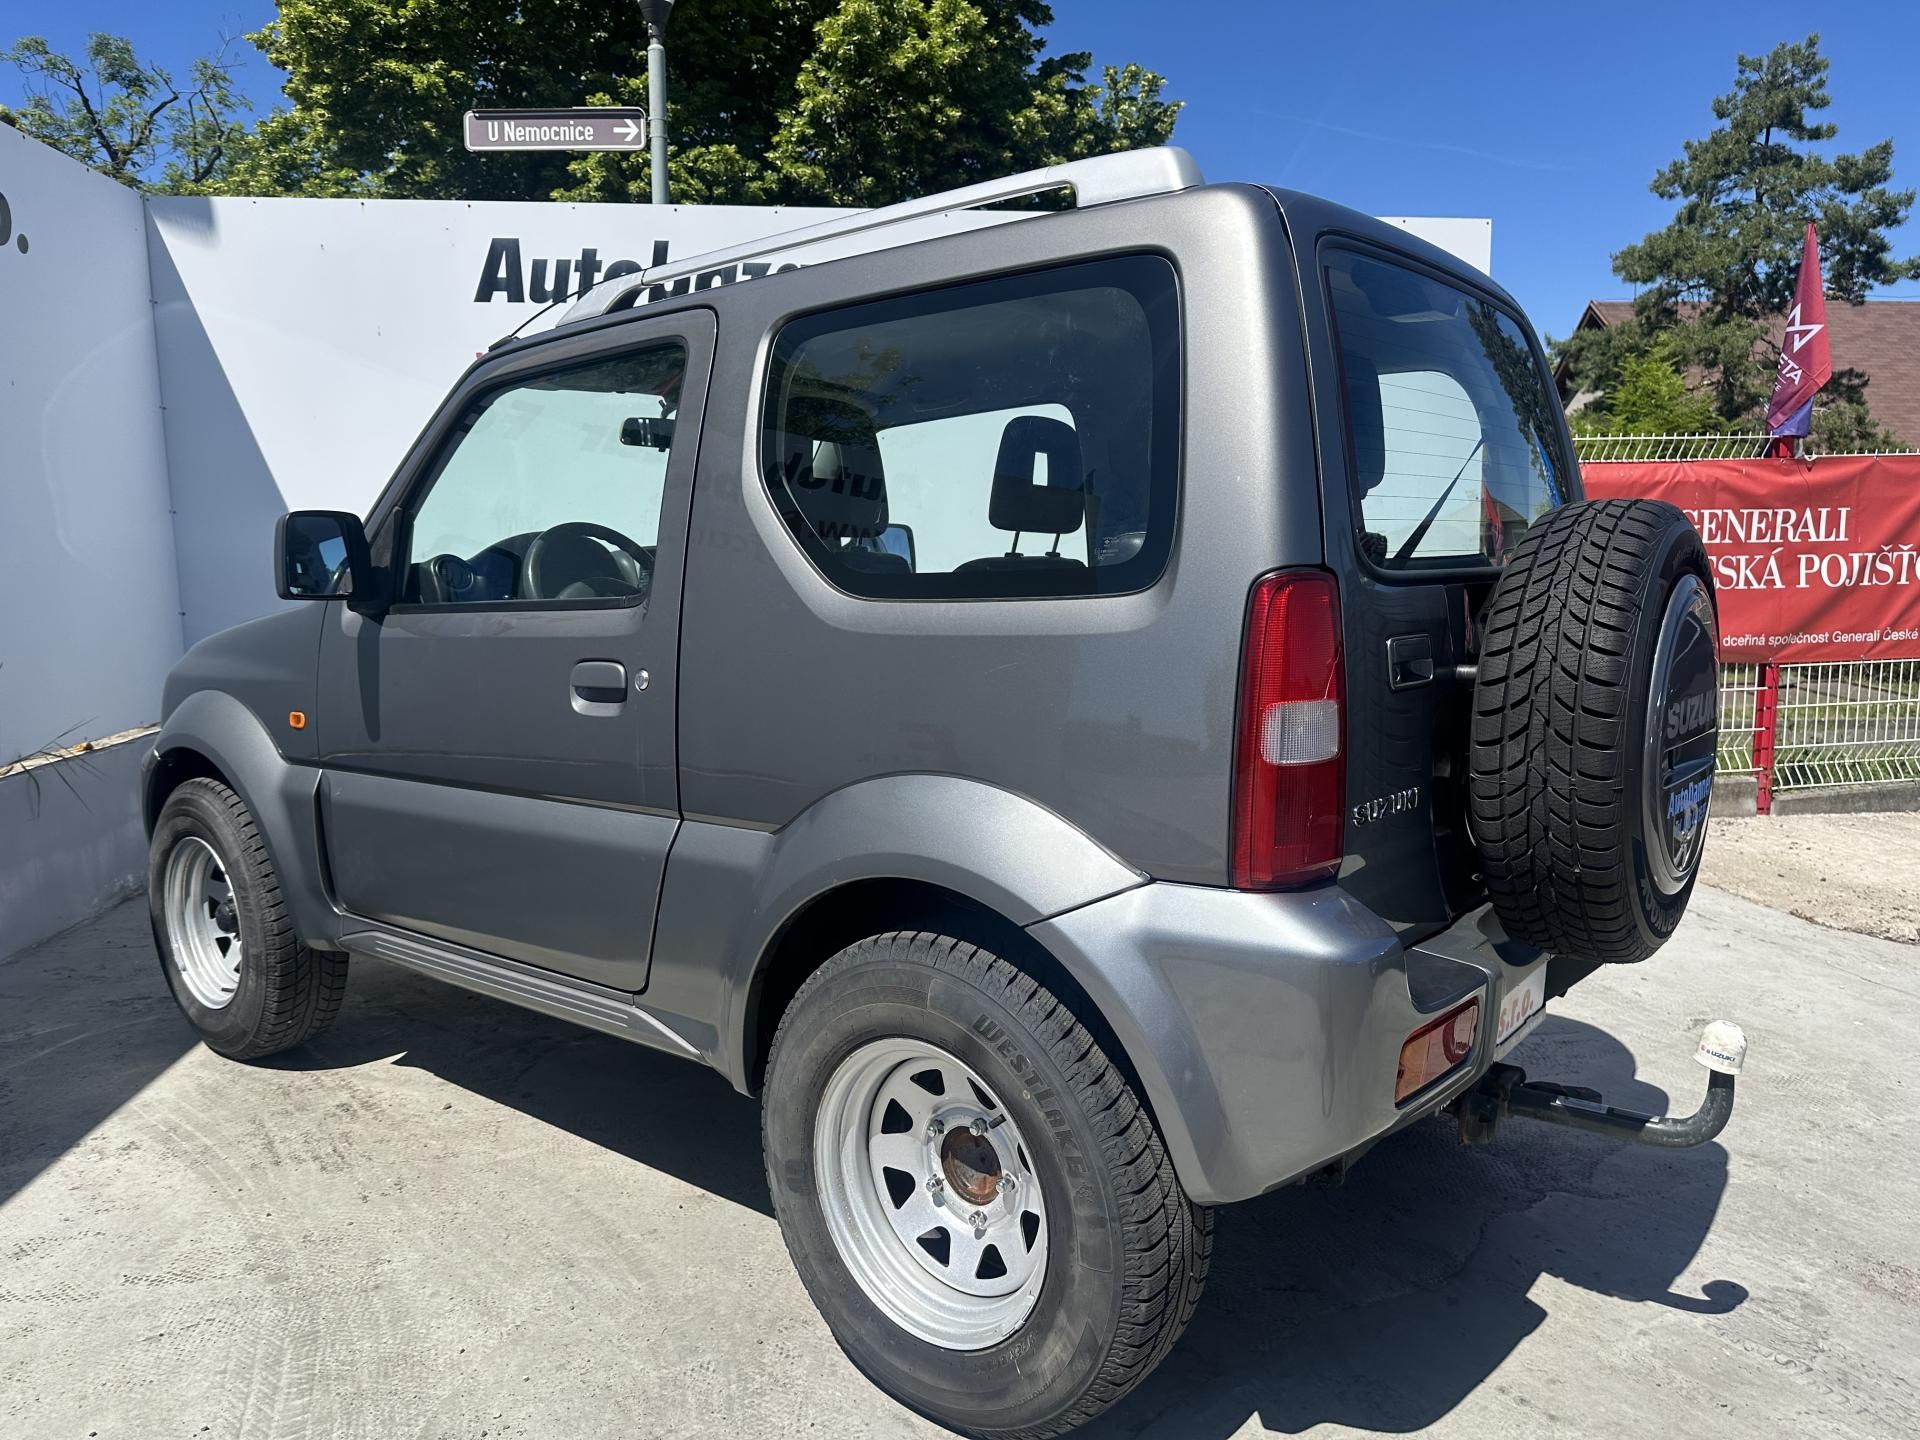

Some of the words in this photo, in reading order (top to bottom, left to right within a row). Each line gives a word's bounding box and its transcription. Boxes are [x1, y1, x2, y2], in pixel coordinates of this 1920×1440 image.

[488, 121, 498, 142] U
[504, 120, 594, 142] Nemocnice
[1723, 632, 1765, 647] dceřiná
[1768, 629, 1829, 648] společnost
[1832, 629, 1881, 644] Generali
[1883, 627, 1918, 642] České
[1353, 786, 1420, 828] SUZUKI
[972, 1013, 1089, 1179] WESTLAKE
